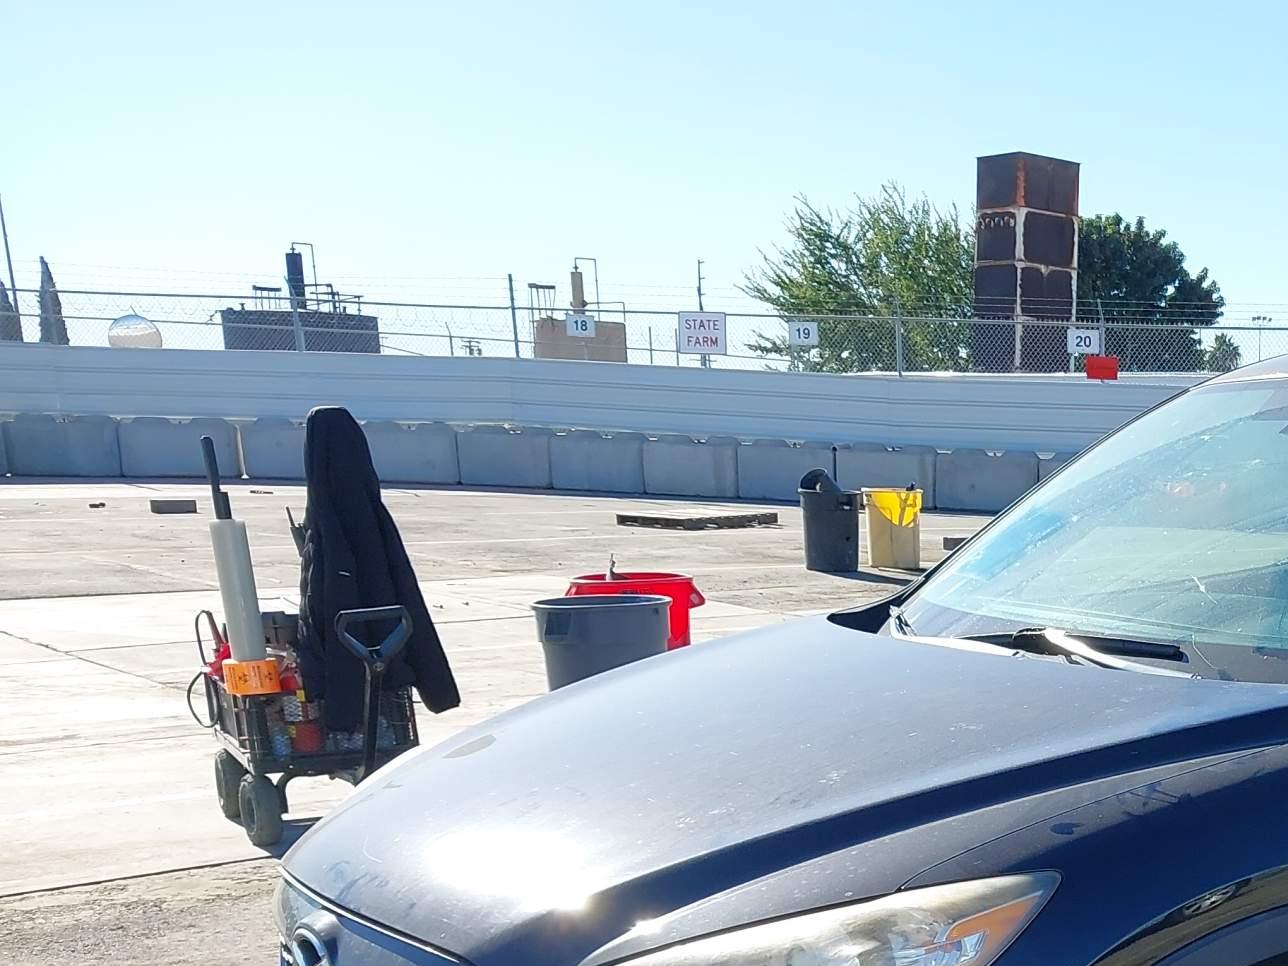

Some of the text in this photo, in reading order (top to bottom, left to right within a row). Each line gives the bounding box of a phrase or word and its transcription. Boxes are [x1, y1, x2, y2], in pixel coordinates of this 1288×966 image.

[573, 319, 588, 332] 18
[684, 319, 720, 331] STATE
[796, 327, 810, 339] 19
[687, 336, 719, 348] FARM
[1075, 335, 1092, 348] 20
